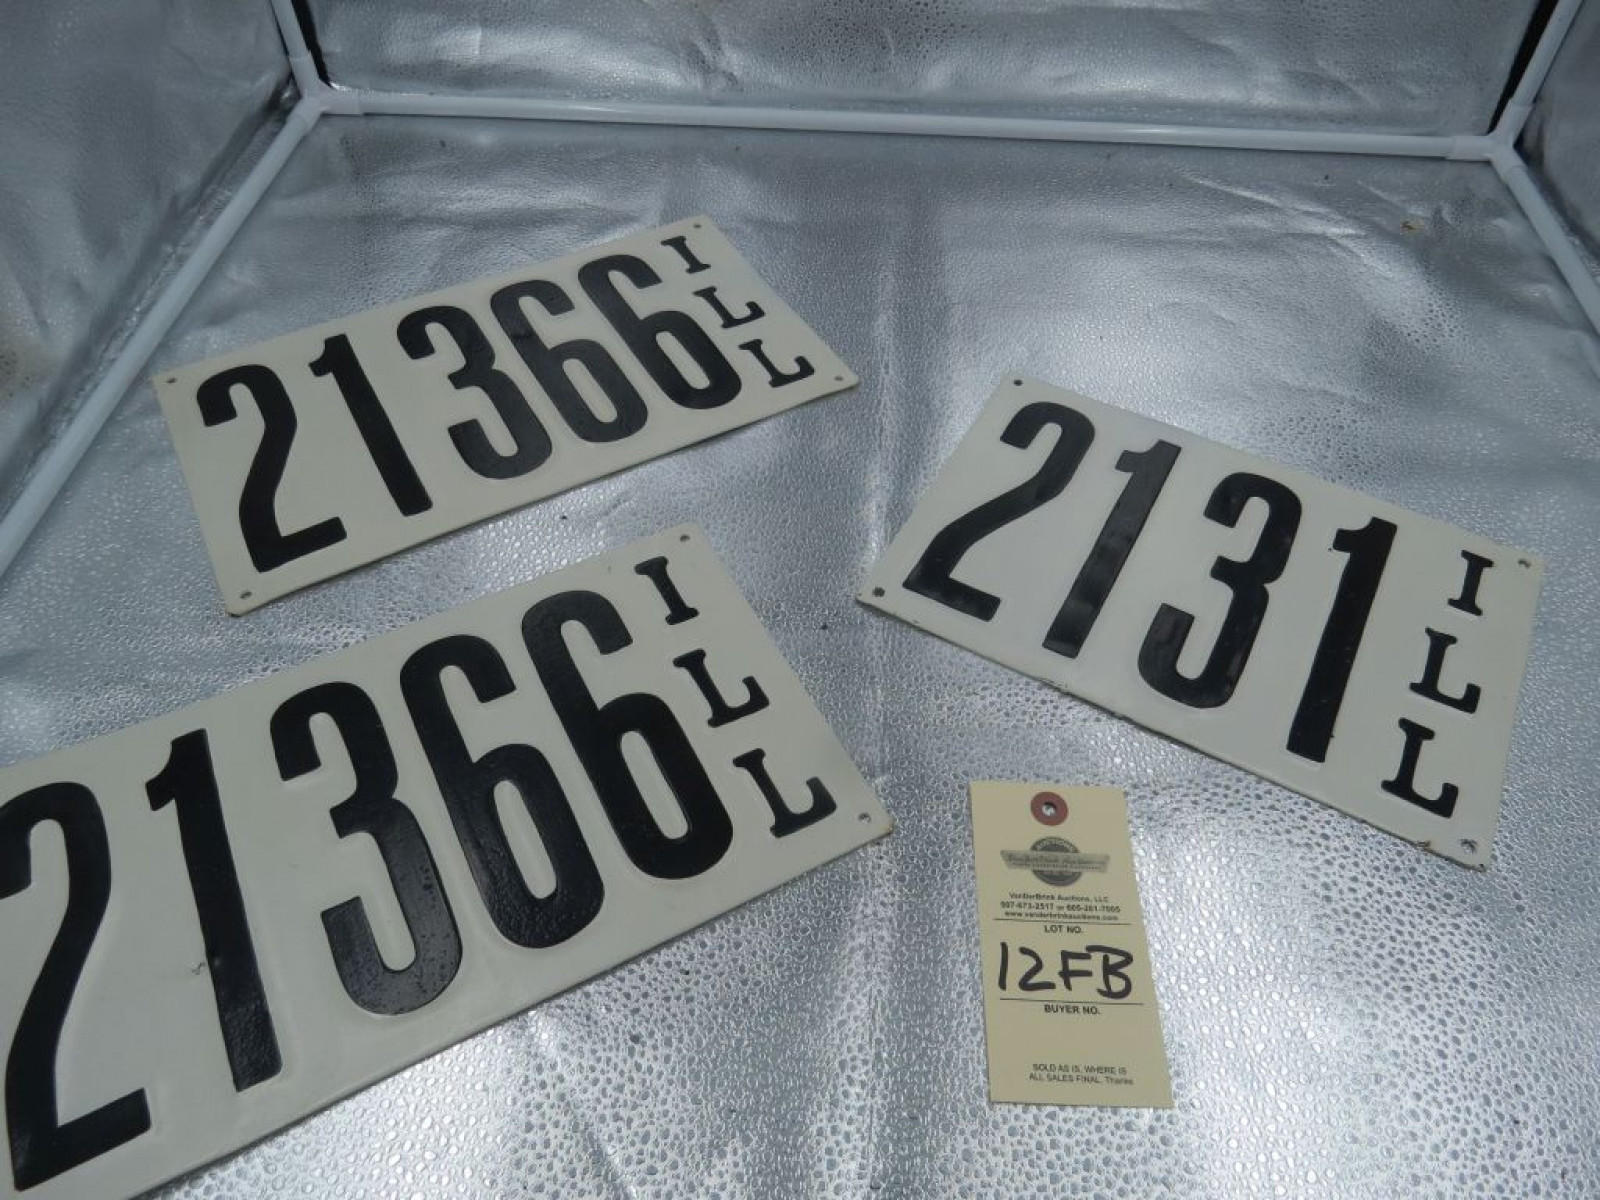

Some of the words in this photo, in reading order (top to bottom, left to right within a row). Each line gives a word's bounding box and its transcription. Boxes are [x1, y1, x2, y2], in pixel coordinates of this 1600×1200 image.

[196, 254, 742, 573] 21366
[902, 401, 1398, 763] 2131
[0, 589, 734, 1192] 21366
[1044, 924, 1064, 934] LOT
[1066, 925, 1083, 934] NO.
[998, 941, 1133, 999] 12FB
[1044, 1004, 1080, 1014] BUYER
[1082, 1004, 1101, 1015] NO.
[1029, 1072, 1045, 1081] ALL
[1046, 1073, 1074, 1083] SALES
[1032, 1063, 1057, 1073] SOLD
[1057, 1063, 1070, 1073] AS
[1084, 1064, 1117, 1075] WHERE
